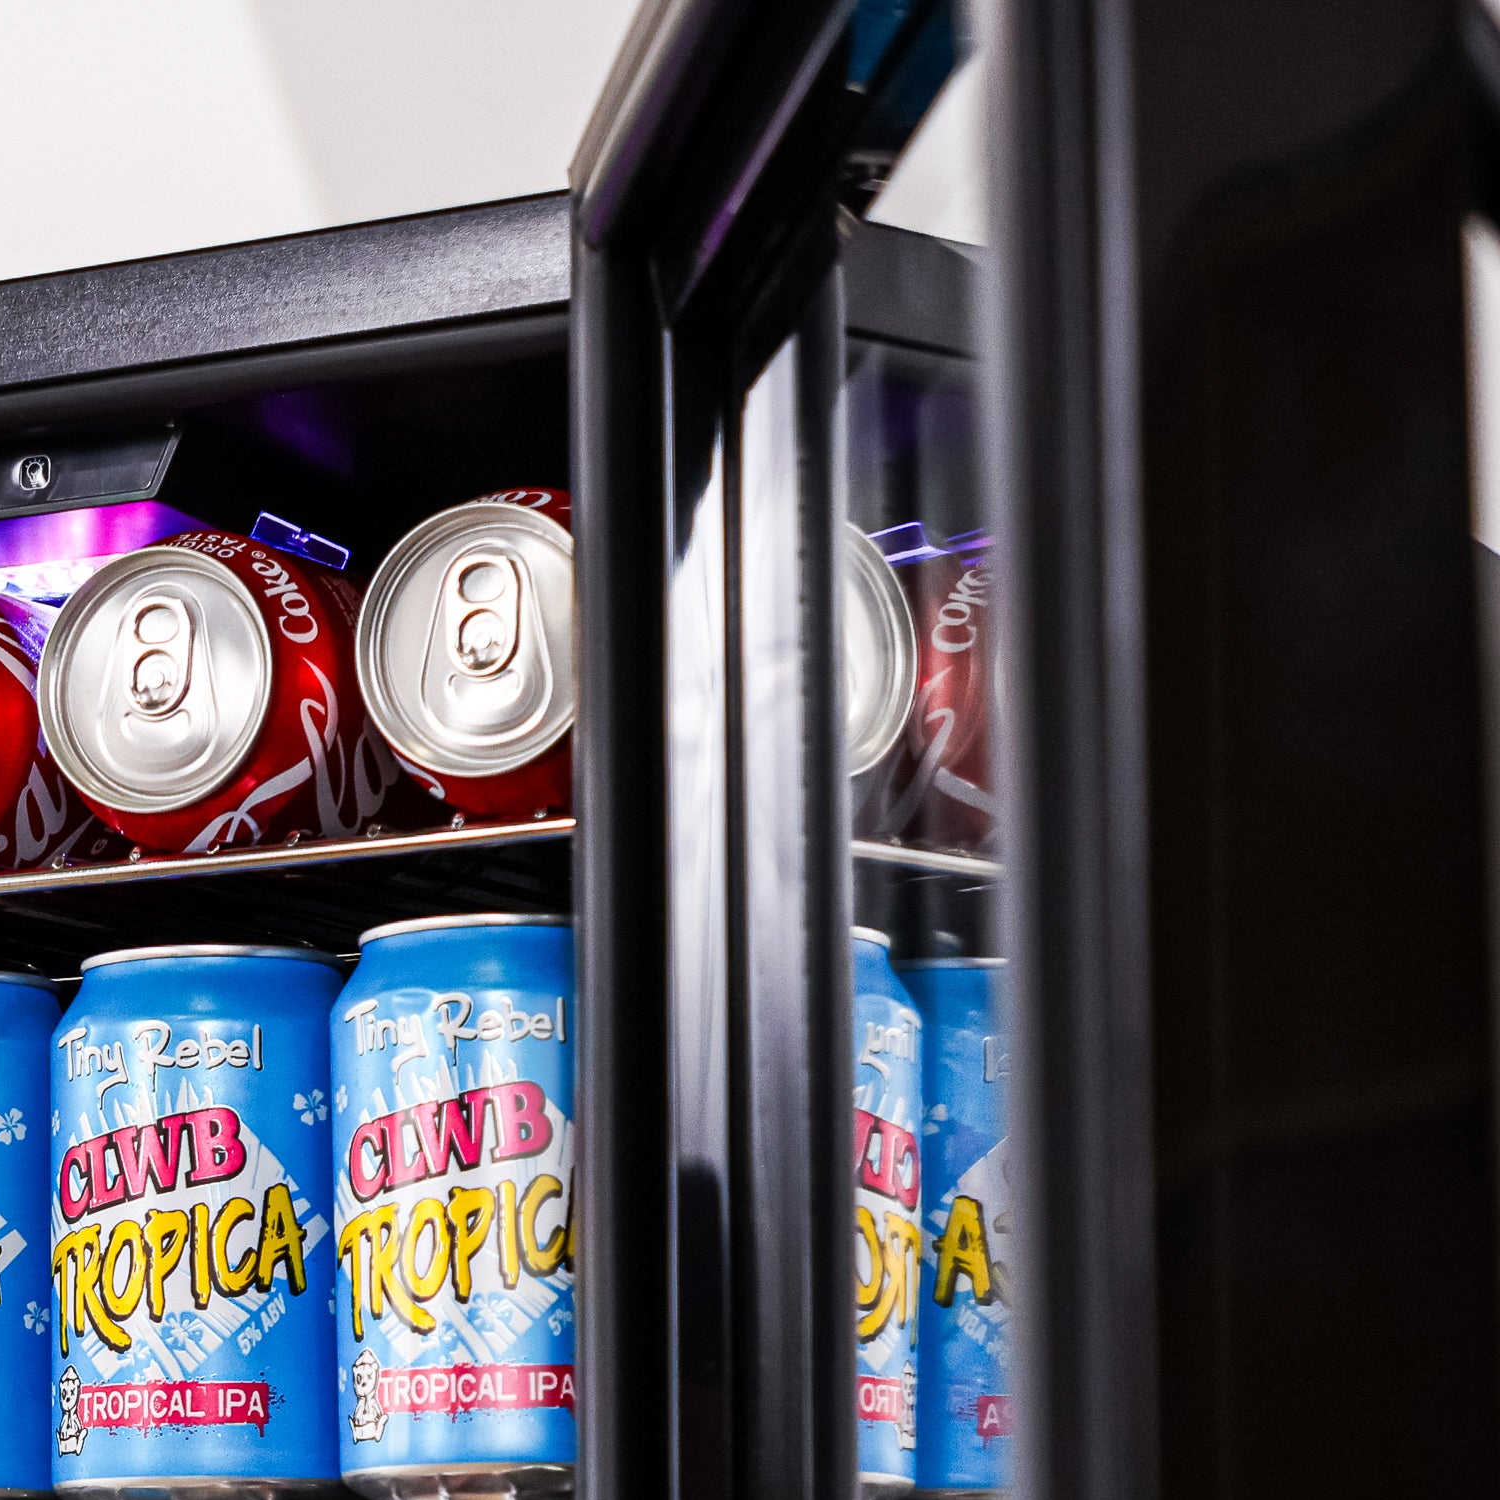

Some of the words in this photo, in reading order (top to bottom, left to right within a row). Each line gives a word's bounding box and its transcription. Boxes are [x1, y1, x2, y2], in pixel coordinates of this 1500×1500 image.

[58, 1027, 129, 1111] Tiny
[133, 1020, 263, 1096] Rebel
[344, 998, 428, 1085] Tiny
[432, 992, 566, 1066] Rebel
[56, 1106, 248, 1225] CLWB
[350, 1080, 552, 1203] CLWB
[52, 1181, 308, 1358] TROPICA
[237, 1321, 263, 1356] 5%
[260, 1292, 286, 1333] ABV
[80, 1389, 205, 1422] TROPICAL
[218, 1389, 265, 1420] IPA
[379, 1373, 517, 1407] TROPICAL
[529, 1372, 575, 1401] IPA
